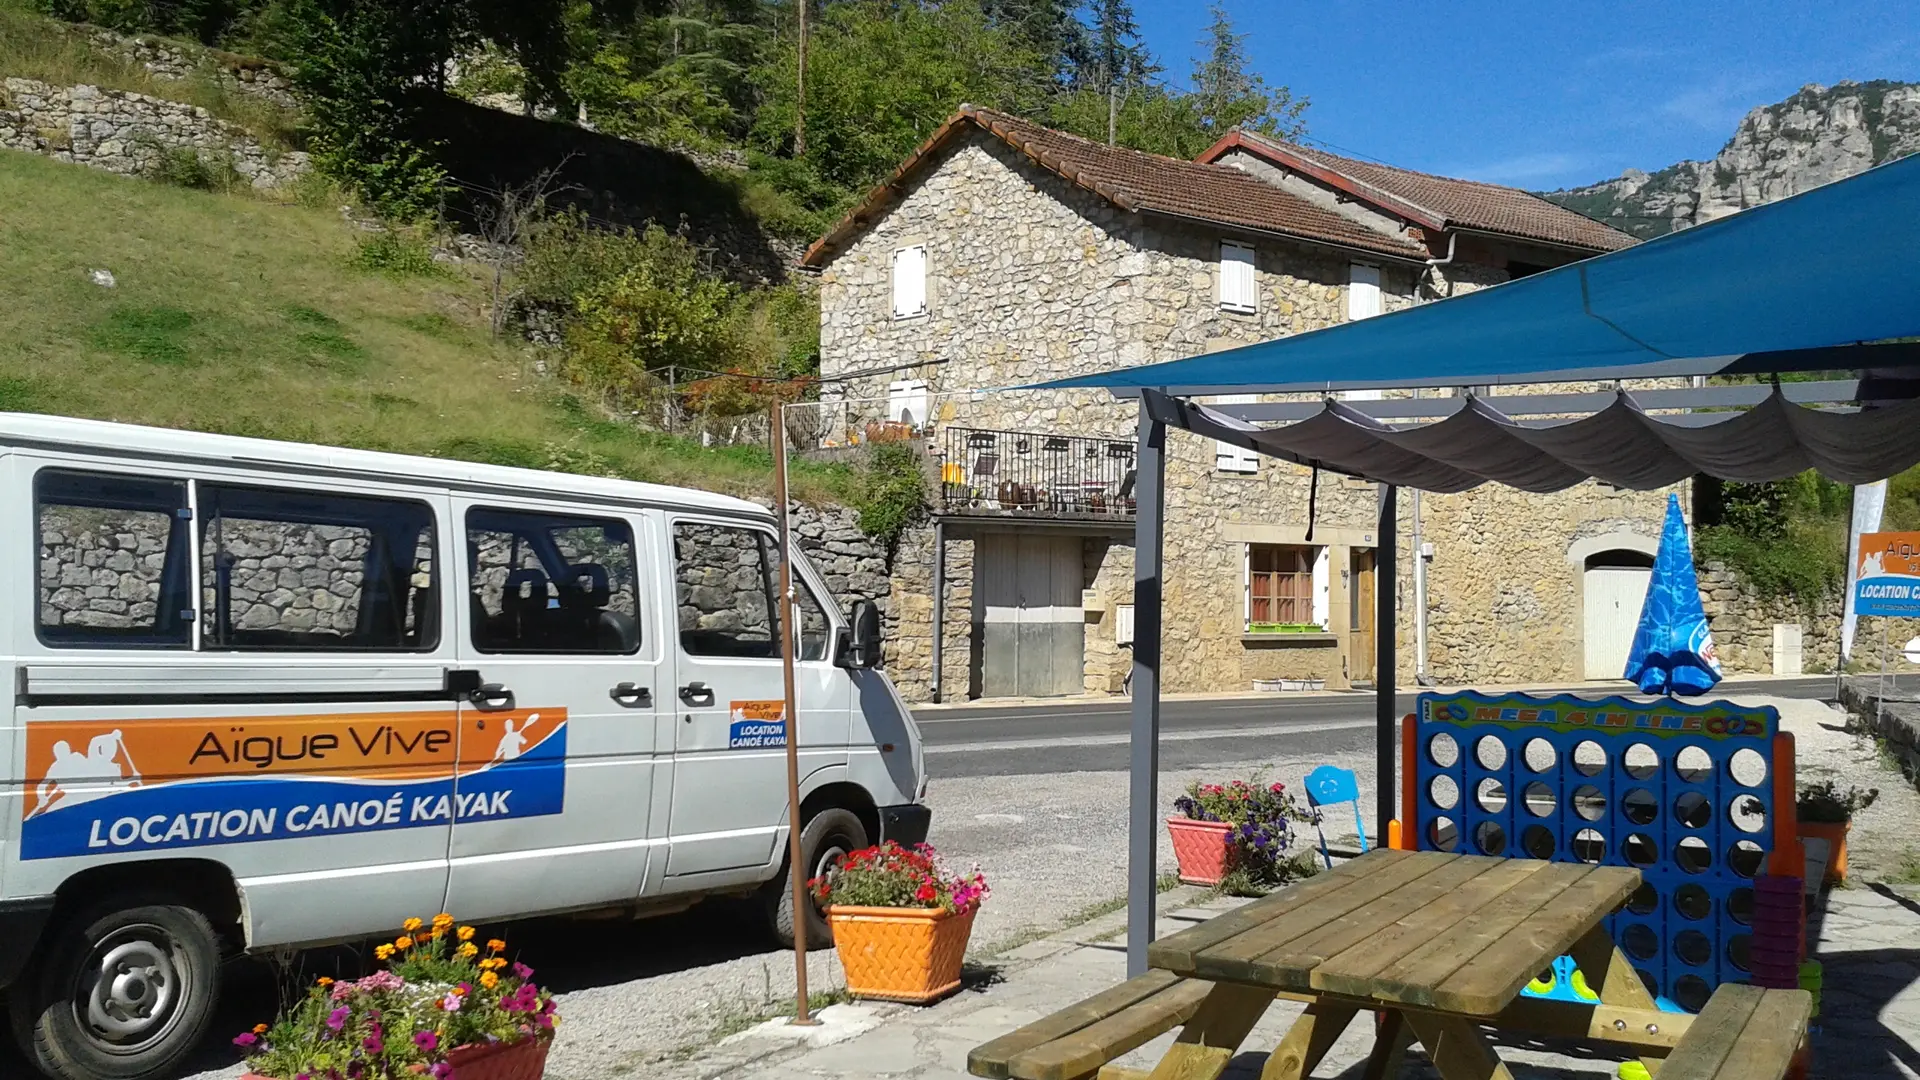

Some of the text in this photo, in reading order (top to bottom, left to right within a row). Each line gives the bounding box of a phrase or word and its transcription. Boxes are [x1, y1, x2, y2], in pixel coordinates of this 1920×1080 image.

[1860, 584, 1910, 599] LOCATION
[1473, 706, 1704, 731] MEGA 4 IN LINE
[740, 725, 783, 735] LOCATION
[189, 726, 452, 768] Aïgue Vive
[731, 734, 763, 747] CANOÉ
[88, 790, 512, 848] LOCATION CANOÉ KAYAK
